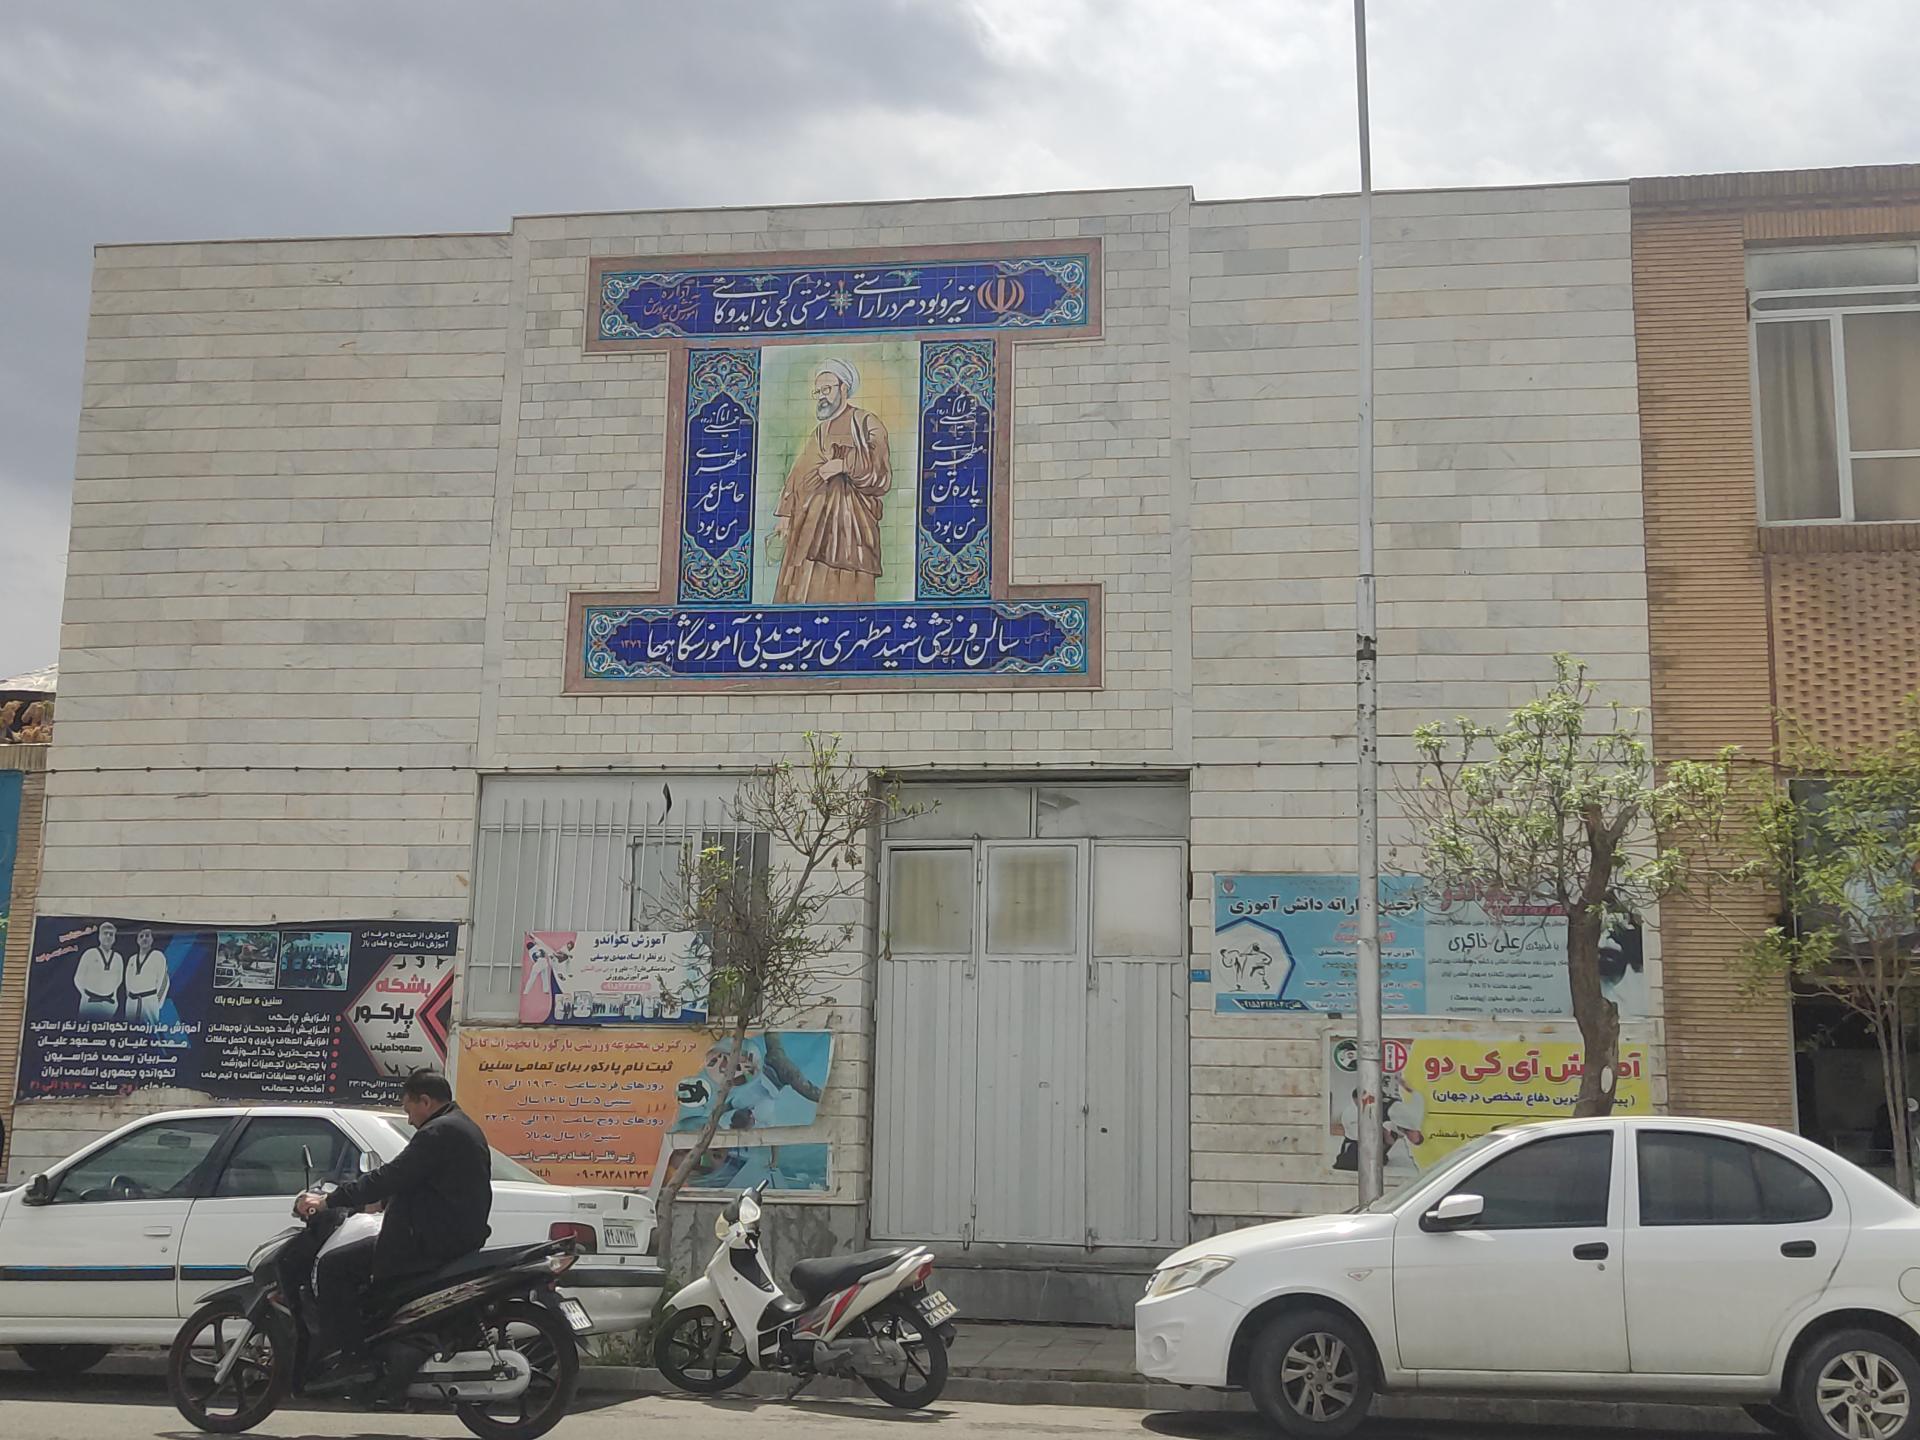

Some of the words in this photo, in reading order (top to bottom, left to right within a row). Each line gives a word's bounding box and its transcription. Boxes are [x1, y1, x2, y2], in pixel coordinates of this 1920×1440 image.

[930, 471, 958, 503] تن
[692, 481, 719, 509] عمر
[703, 478, 745, 512] حاصل
[697, 519, 714, 544] بود
[715, 518, 738, 541] من
[934, 519, 951, 544] بود
[953, 516, 976, 540] من
[761, 615, 830, 671] تربیت
[819, 616, 892, 666] مطهری
[871, 614, 922, 668] شهید
[964, 616, 1020, 667] سالن
[1229, 895, 1279, 915] آموزی
[1283, 896, 1324, 915] دانش
[593, 934, 629, 948] تکواندو
[632, 933, 670, 948] آموزش
[1448, 932, 1488, 954] ذاکری
[1494, 932, 1520, 953] علی
[353, 1003, 415, 1029] پارکور
[77, 1021, 90, 1033] زیر
[91, 1021, 128, 1033] تکواندو
[129, 1021, 152, 1035] رزمی
[386, 1029, 410, 1040] شهید
[68, 1036, 107, 1048] مسعود
[109, 1038, 116, 1048] و
[149, 1037, 188, 1048] مهدی
[574, 1040, 609, 1053] ورزشی
[610, 1041, 650, 1053] مجموعه
[44, 1051, 99, 1062] فدراسیون
[102, 1052, 135, 1064] رسمی
[136, 1052, 178, 1064] مربیان
[41, 1066, 63, 1077] ایران
[64, 1066, 98, 1077] اسلامی
[478, 1060, 513, 1072] سنین
[515, 1061, 554, 1073] تمامی
[555, 1061, 582, 1073] برای
[583, 1061, 621, 1075] پارکور
[622, 1061, 645, 1075] نام
[646, 1060, 673, 1072] ثبت
[1424, 1057, 1455, 1081] دو
[1459, 1050, 1502, 1082] کی
[1508, 1050, 1540, 1083] آی
[99, 1067, 138, 1078] جمهوری
[138, 1067, 176, 1079] تکواندو
[89, 1081, 118, 1090] ساعت
[503, 1080, 521, 1091] الی
[600, 1081, 619, 1092] فرد
[622, 1081, 664, 1092] روزهای
[517, 1096, 540, 1107] سال
[569, 1096, 592, 1107] سال
[1433, 1090, 1468, 1102] جهان)
[1469, 1092, 1480, 1103] در
[1482, 1092, 1525, 1105] شخصی
[1525, 1094, 1550, 1106] دفاع
[521, 1115, 540, 1126] الی
[623, 1115, 664, 1126] روزهای
[553, 1131, 575, 1142] سال
[594, 1151, 616, 1164] نظر
[616, 1151, 637, 1164] زیر
